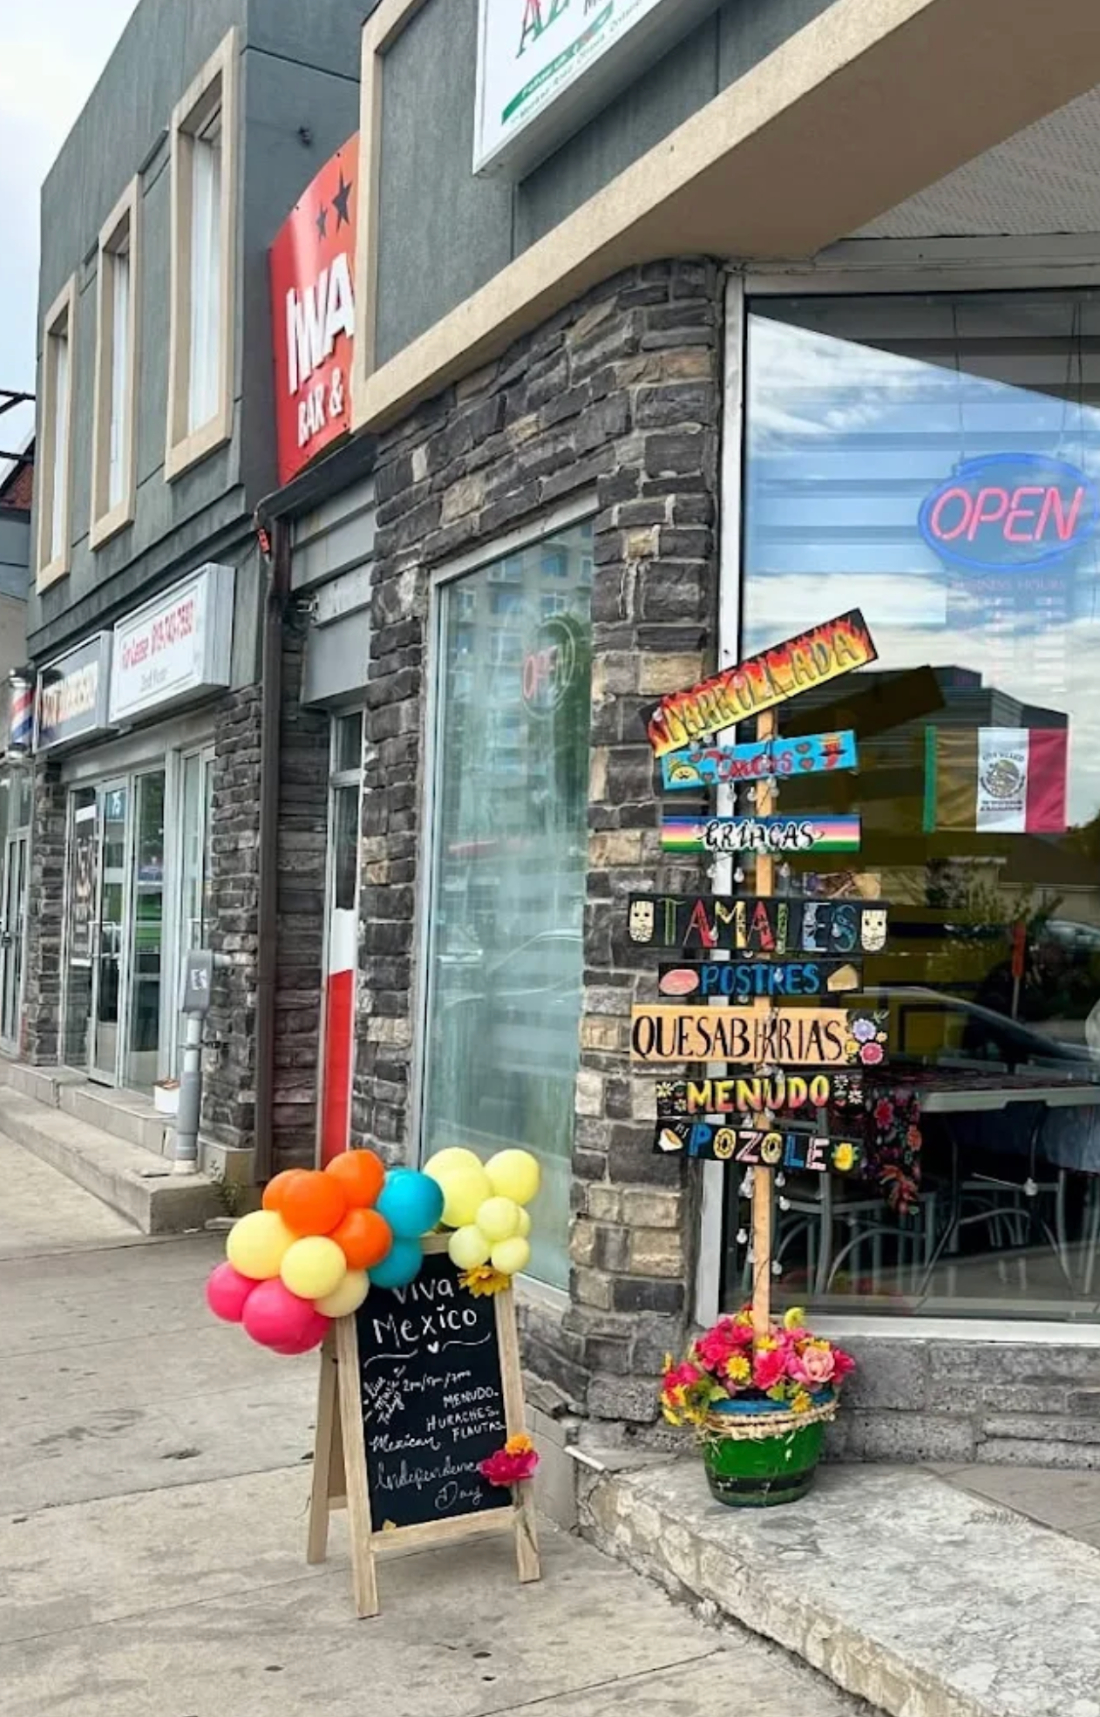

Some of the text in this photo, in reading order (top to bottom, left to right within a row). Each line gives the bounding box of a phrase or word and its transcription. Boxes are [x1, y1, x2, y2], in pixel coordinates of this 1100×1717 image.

[298, 367, 344, 447] BAR &
[930, 486, 1086, 542] OPEN
[659, 897, 858, 954] TAMALES
[700, 963, 821, 996] POSTRES
[686, 1074, 830, 1115] MENUDO
[688, 1122, 830, 1172] POZOLE
